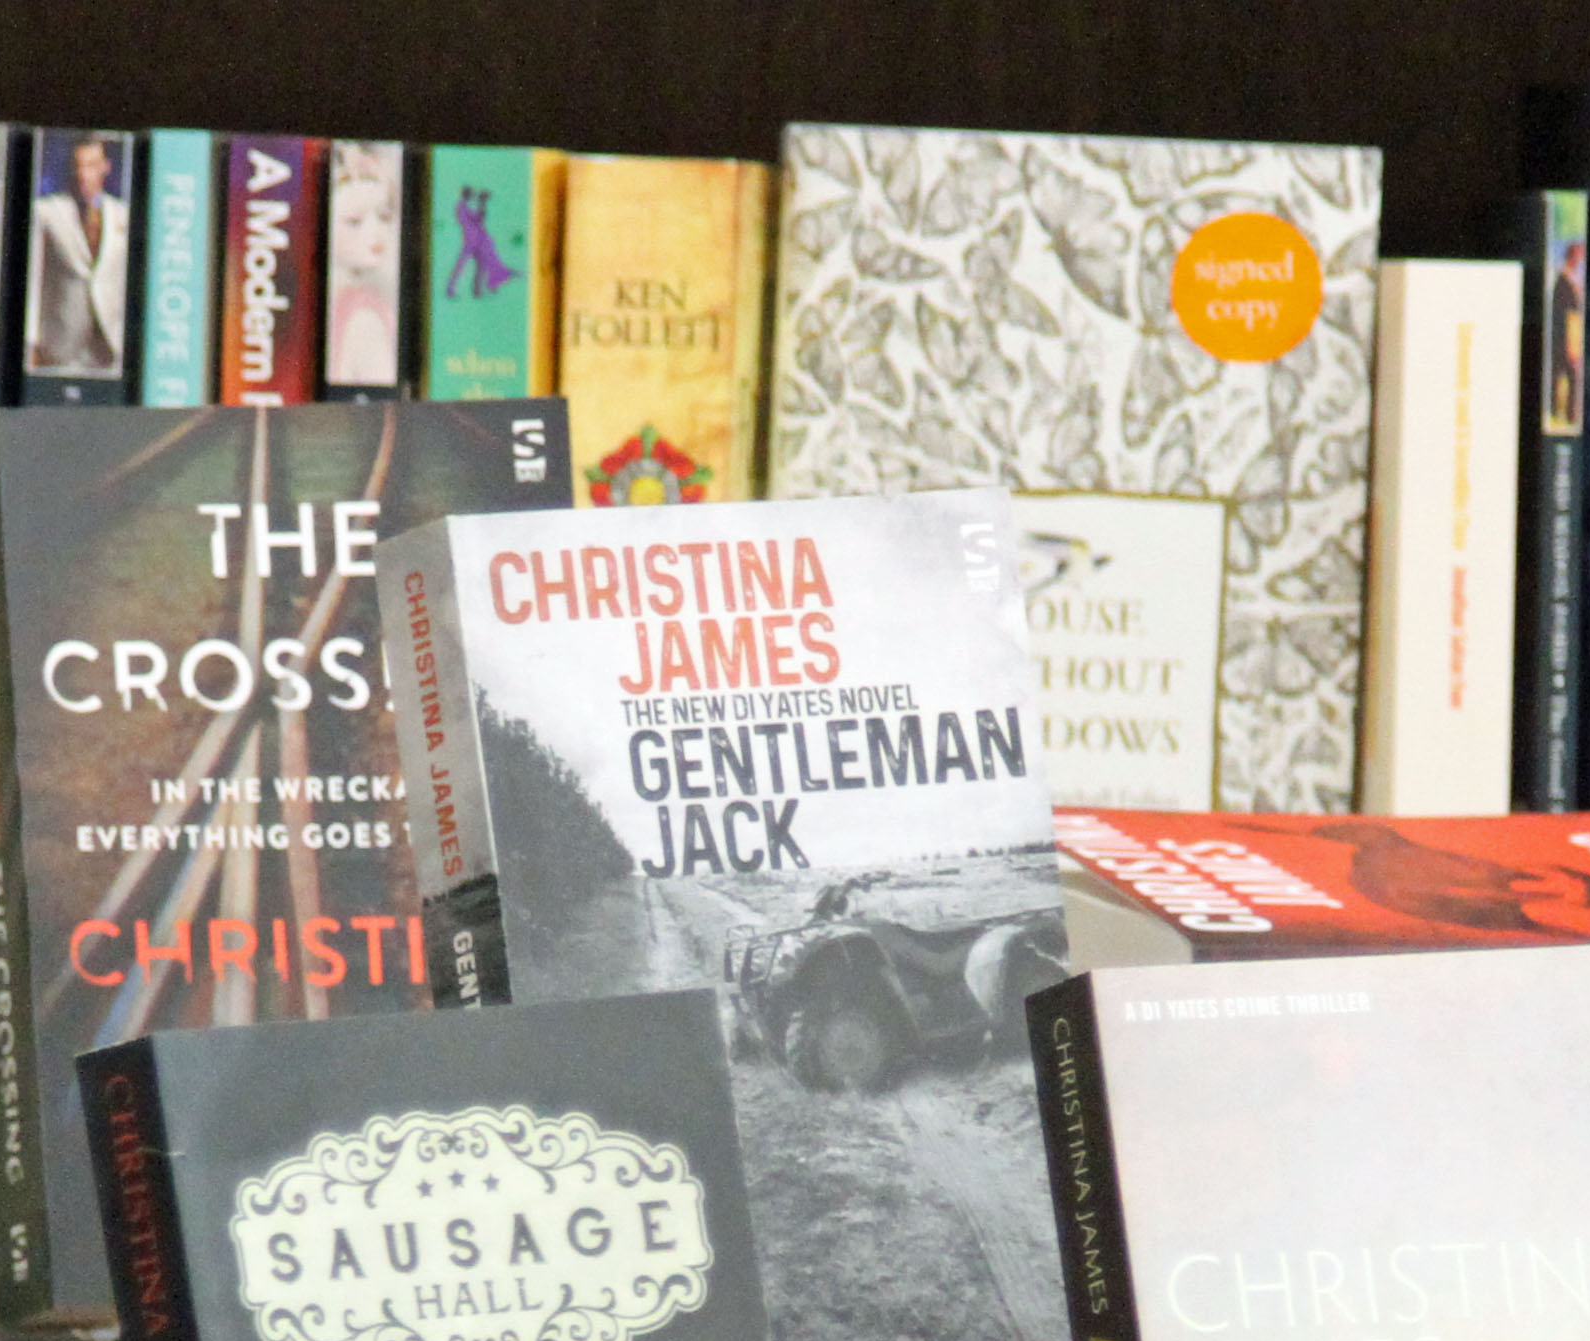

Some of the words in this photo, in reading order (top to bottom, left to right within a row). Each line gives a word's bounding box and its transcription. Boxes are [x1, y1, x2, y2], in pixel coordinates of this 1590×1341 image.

[245, 148, 292, 191] A
[239, 199, 290, 381] Modern
[614, 279, 687, 311] KEN
[1193, 251, 1295, 290] signed
[569, 312, 722, 351] FOLLETT
[1206, 297, 1285, 330] copy
[197, 500, 381, 579] THE
[488, 536, 834, 626] CHRISTINA
[41, 637, 396, 713] CROSS
[618, 611, 842, 696] JAMES
[403, 570, 445, 753] CHRISTINA
[429, 762, 465, 879] JAMES
[620, 697, 668, 727] THE
[670, 694, 726, 724] NEW
[733, 693, 756, 720] DI
[757, 688, 835, 720] YATES
[839, 683, 921, 714] NOVEL
[151, 777, 192, 803] IN
[198, 776, 262, 803] THE
[627, 706, 1029, 802] GENTLEMAN
[76, 823, 289, 852] EVERYTHING
[301, 823, 392, 850] GOES
[640, 797, 812, 881] JACK
[69, 916, 425, 988] CHRISTI
[1141, 1000, 1162, 1021] DI
[1168, 999, 1218, 1021] YATES
[1224, 996, 1282, 1018] CRIME
[1285, 991, 1372, 1014] THRILLER
[1051, 1015, 1093, 1203] CHRISTINA
[1073, 1208, 1110, 1316] JAMES
[267, 1199, 680, 1285] SAUSAGE
[412, 1277, 544, 1321] HALL
